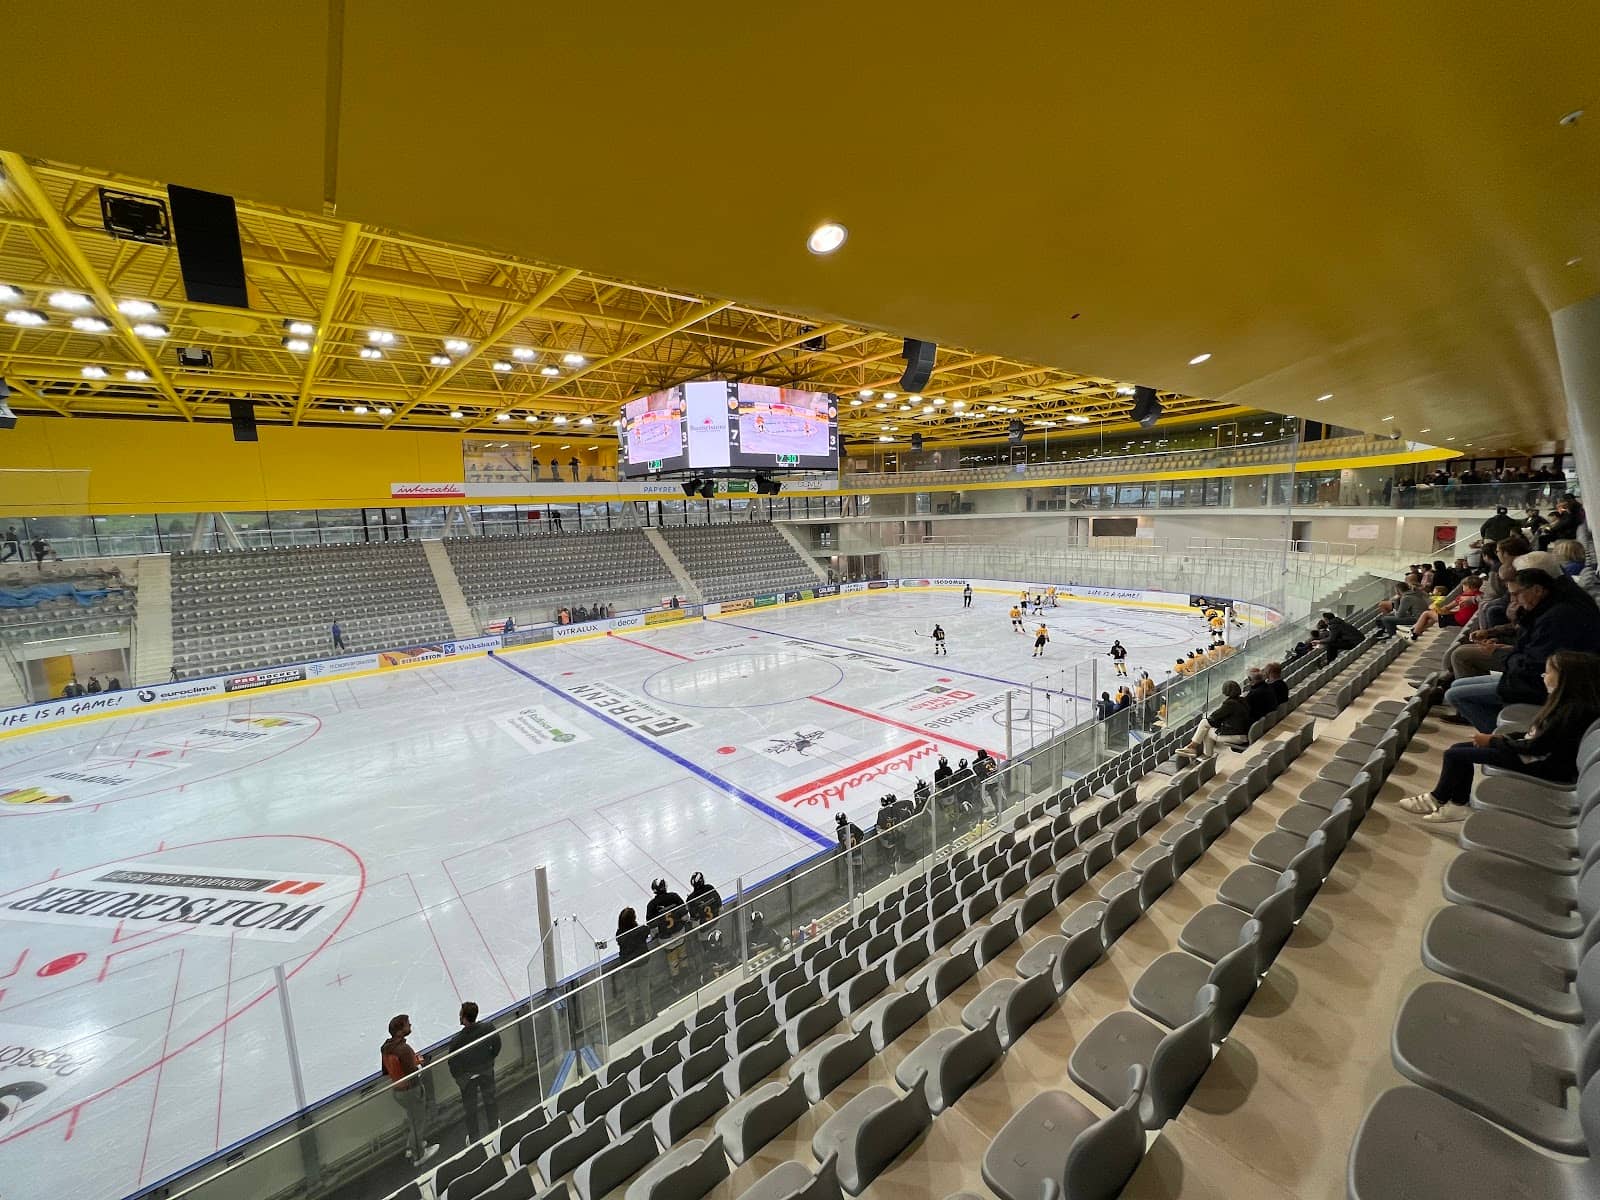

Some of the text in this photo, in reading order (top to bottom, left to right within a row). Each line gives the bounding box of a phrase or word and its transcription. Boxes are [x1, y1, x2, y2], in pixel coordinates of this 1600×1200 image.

[682, 432, 687, 442] 3
[731, 430, 738, 440] 7
[830, 436, 836, 445] 3
[397, 484, 460, 493] intercable
[617, 617, 638, 627] decor
[556, 624, 599, 637] VITRALUX
[458, 640, 500, 651] Volksbank
[234, 675, 257, 684] PRO
[259, 670, 299, 680] HOCKEY
[160, 685, 217, 698] euroclima
[567, 684, 652, 724] PRENN
[0, 696, 123, 726] IFE IS A GAME!
[794, 744, 943, 809] intercable
[8, 887, 325, 931] WOLFSGRUBER
[0, 1046, 94, 1077] Passio
